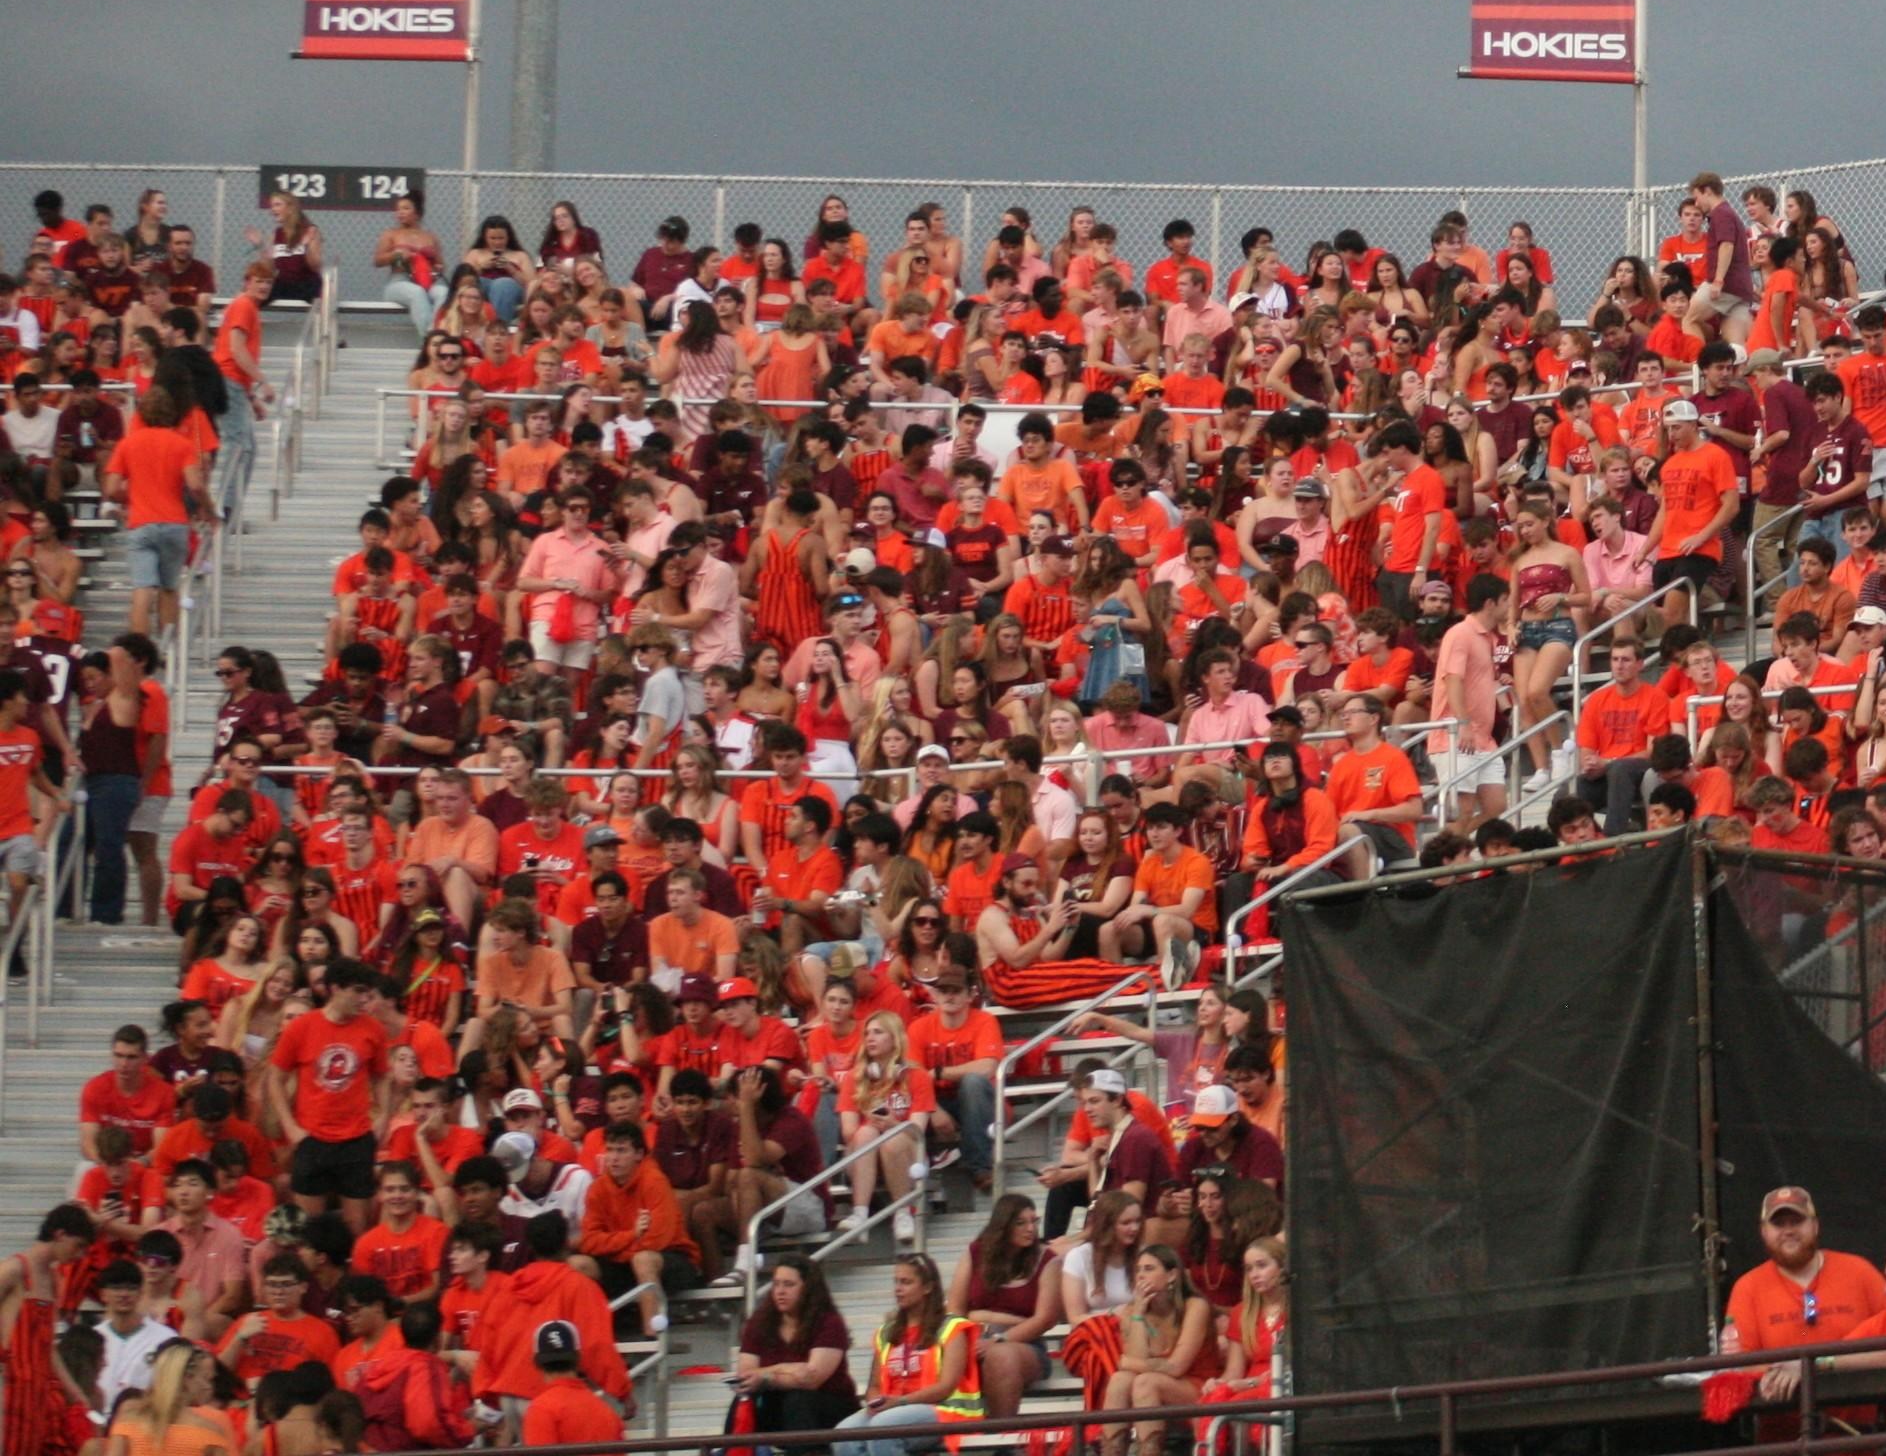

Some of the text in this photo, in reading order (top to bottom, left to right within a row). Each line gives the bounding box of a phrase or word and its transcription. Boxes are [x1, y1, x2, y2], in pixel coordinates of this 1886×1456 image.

[321, 6, 455, 33] HOKIES
[1483, 31, 1627, 60] HOKIES
[275, 173, 410, 199] 123 124
[1812, 446, 1844, 486] 5
